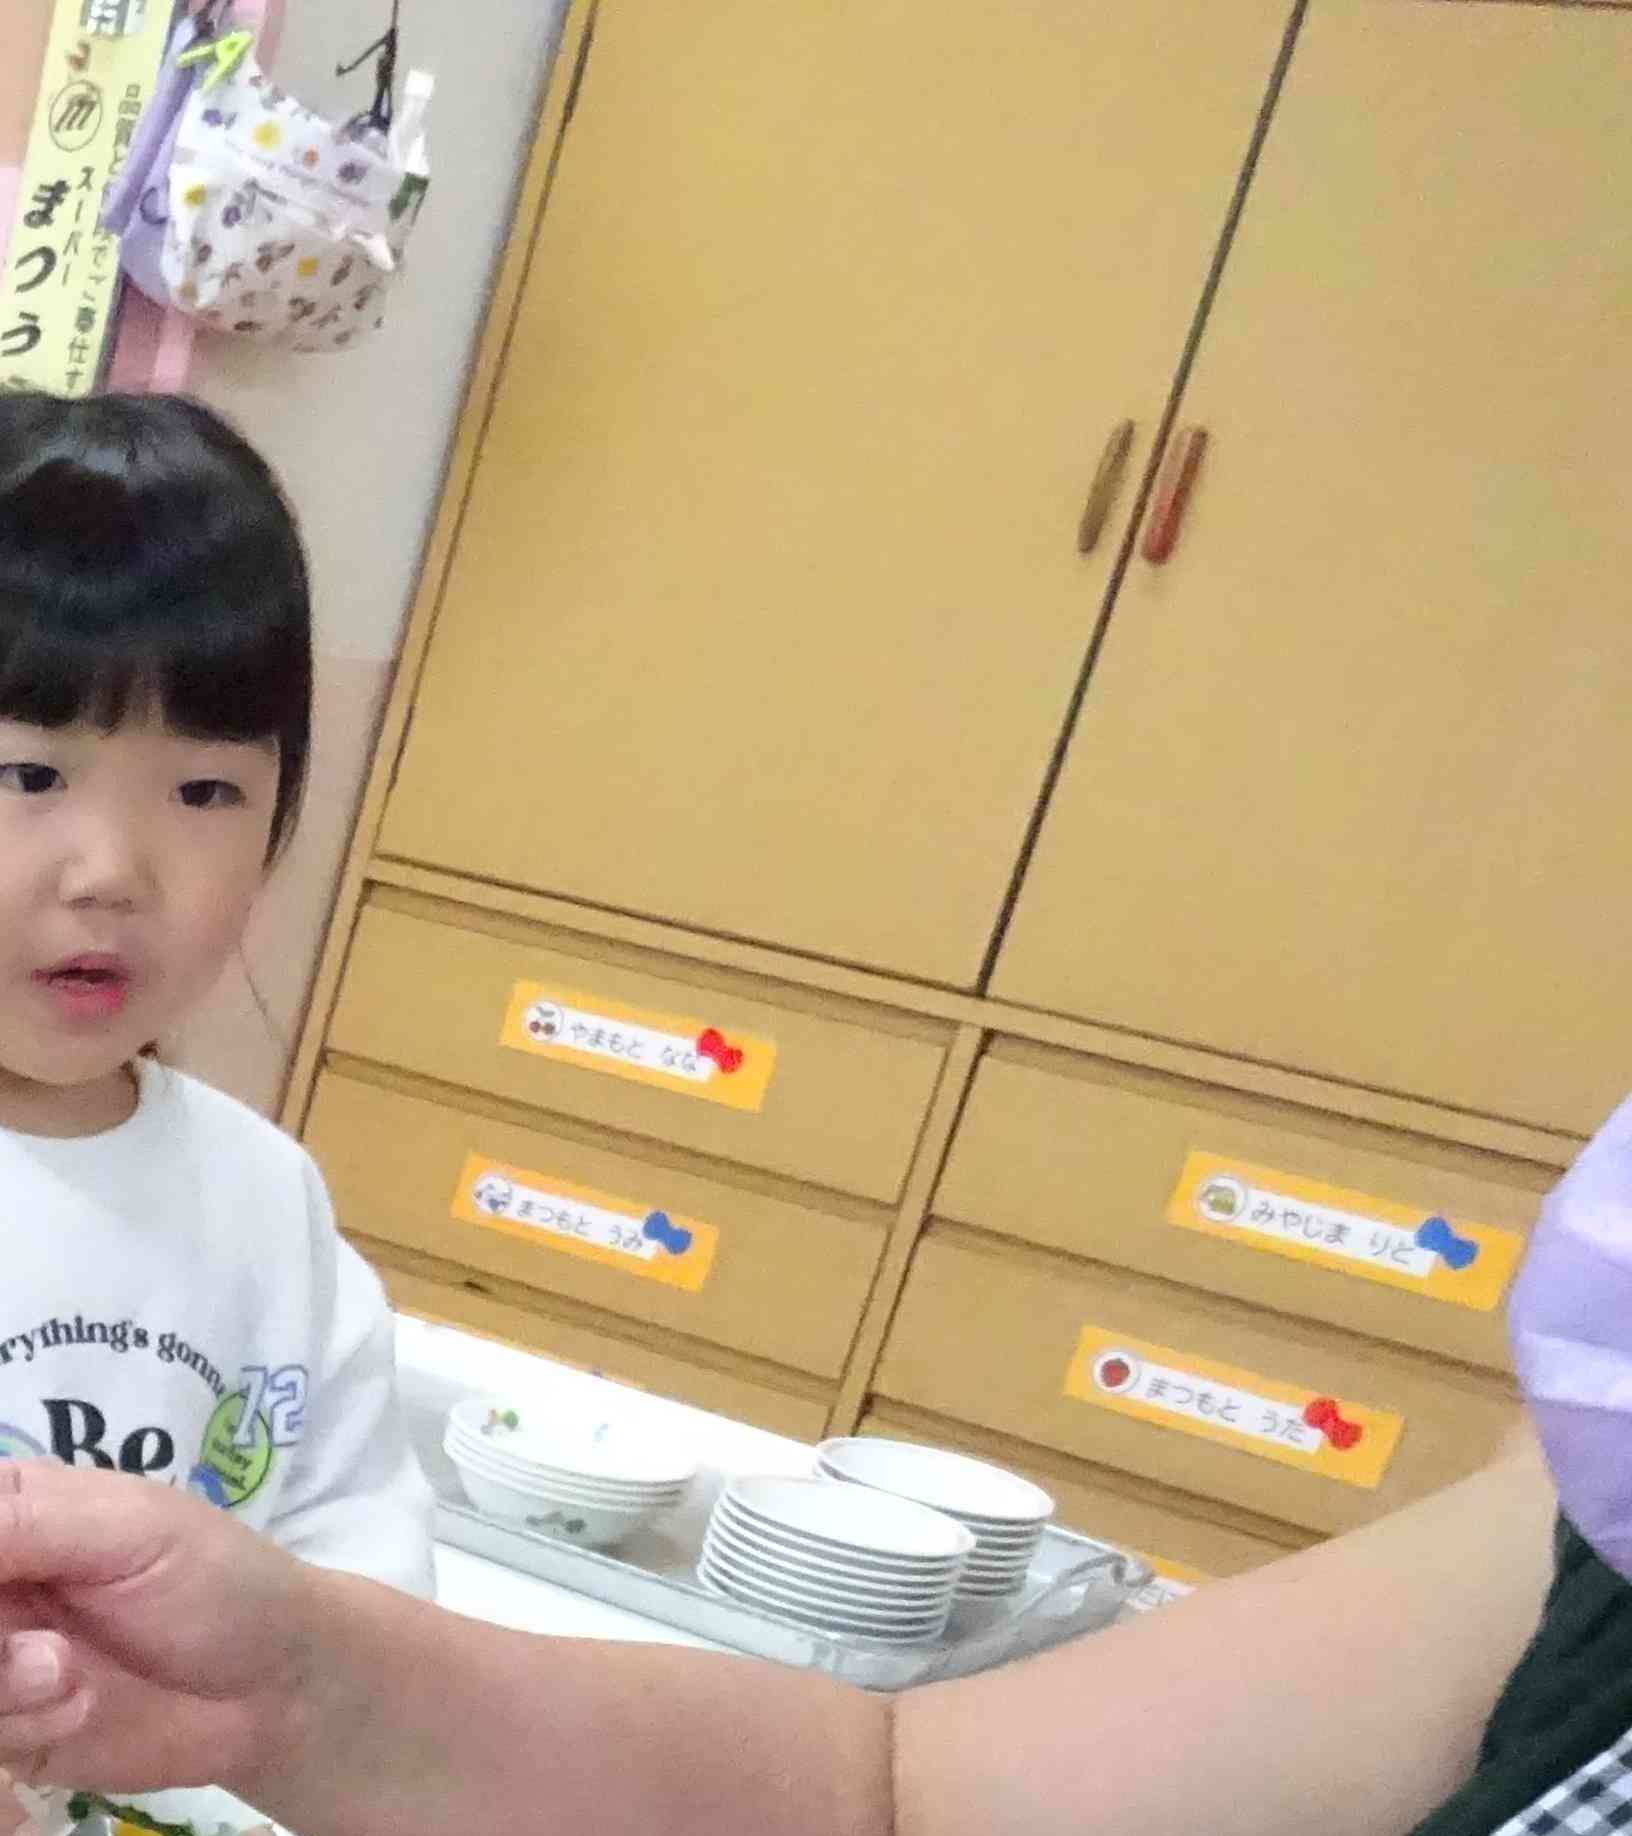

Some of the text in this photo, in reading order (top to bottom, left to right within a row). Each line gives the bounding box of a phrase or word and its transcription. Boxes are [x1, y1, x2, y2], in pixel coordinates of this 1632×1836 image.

[62, 165, 95, 286] スーパー
[0, 179, 71, 392] まつう
[570, 1022, 644, 1059] やまもと
[517, 1200, 592, 1236] まつもと
[1250, 1201, 1415, 1265] みやじま りと
[1146, 1377, 1242, 1423] まつもと
